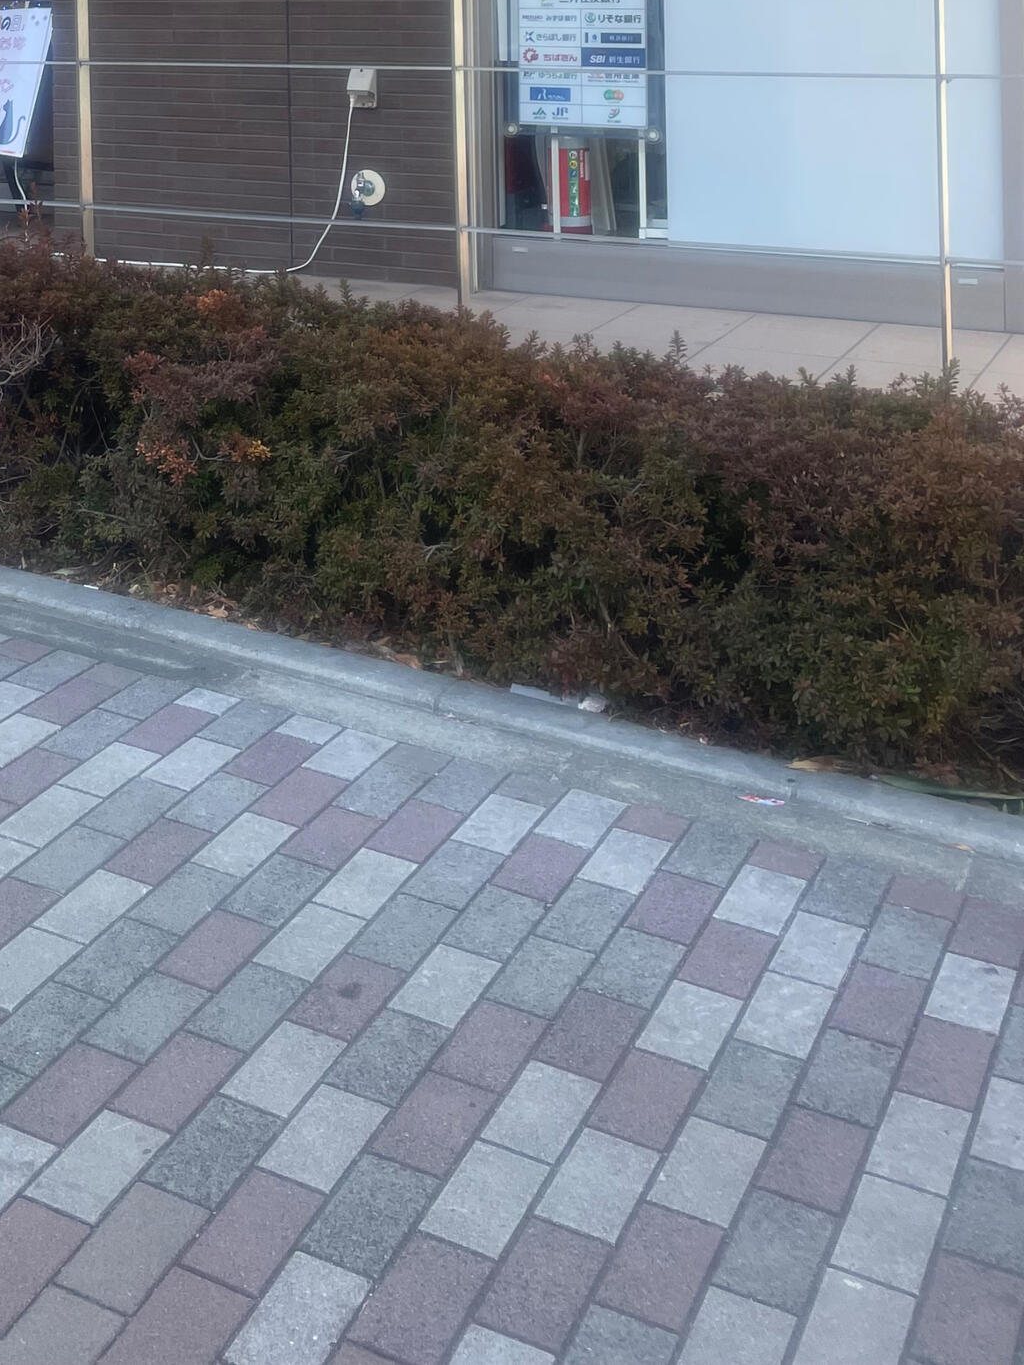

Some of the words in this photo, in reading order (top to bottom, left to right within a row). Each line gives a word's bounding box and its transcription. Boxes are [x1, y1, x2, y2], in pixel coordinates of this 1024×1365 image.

[597, 14, 641, 24] りそな銀行
[590, 55, 607, 64] SBI
[609, 55, 640, 64] 新生銀行
